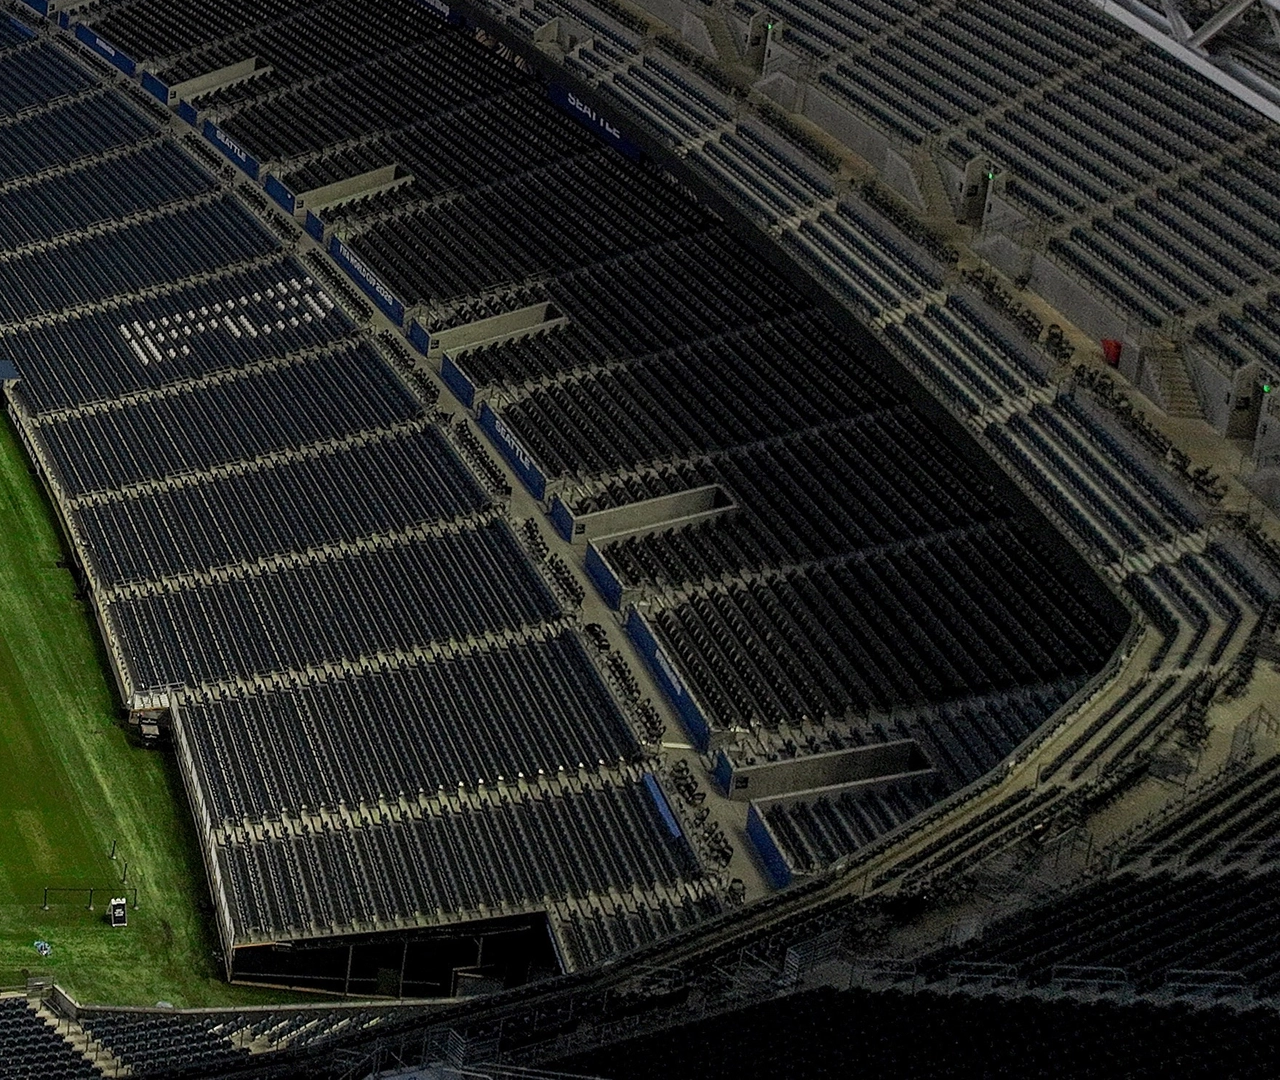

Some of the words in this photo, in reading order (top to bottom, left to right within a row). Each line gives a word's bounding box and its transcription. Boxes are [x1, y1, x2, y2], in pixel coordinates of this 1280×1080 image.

[567, 92, 621, 140] SEATTLE
[216, 131, 247, 161] SEATTLE
[495, 420, 530, 471] SEATTLE
